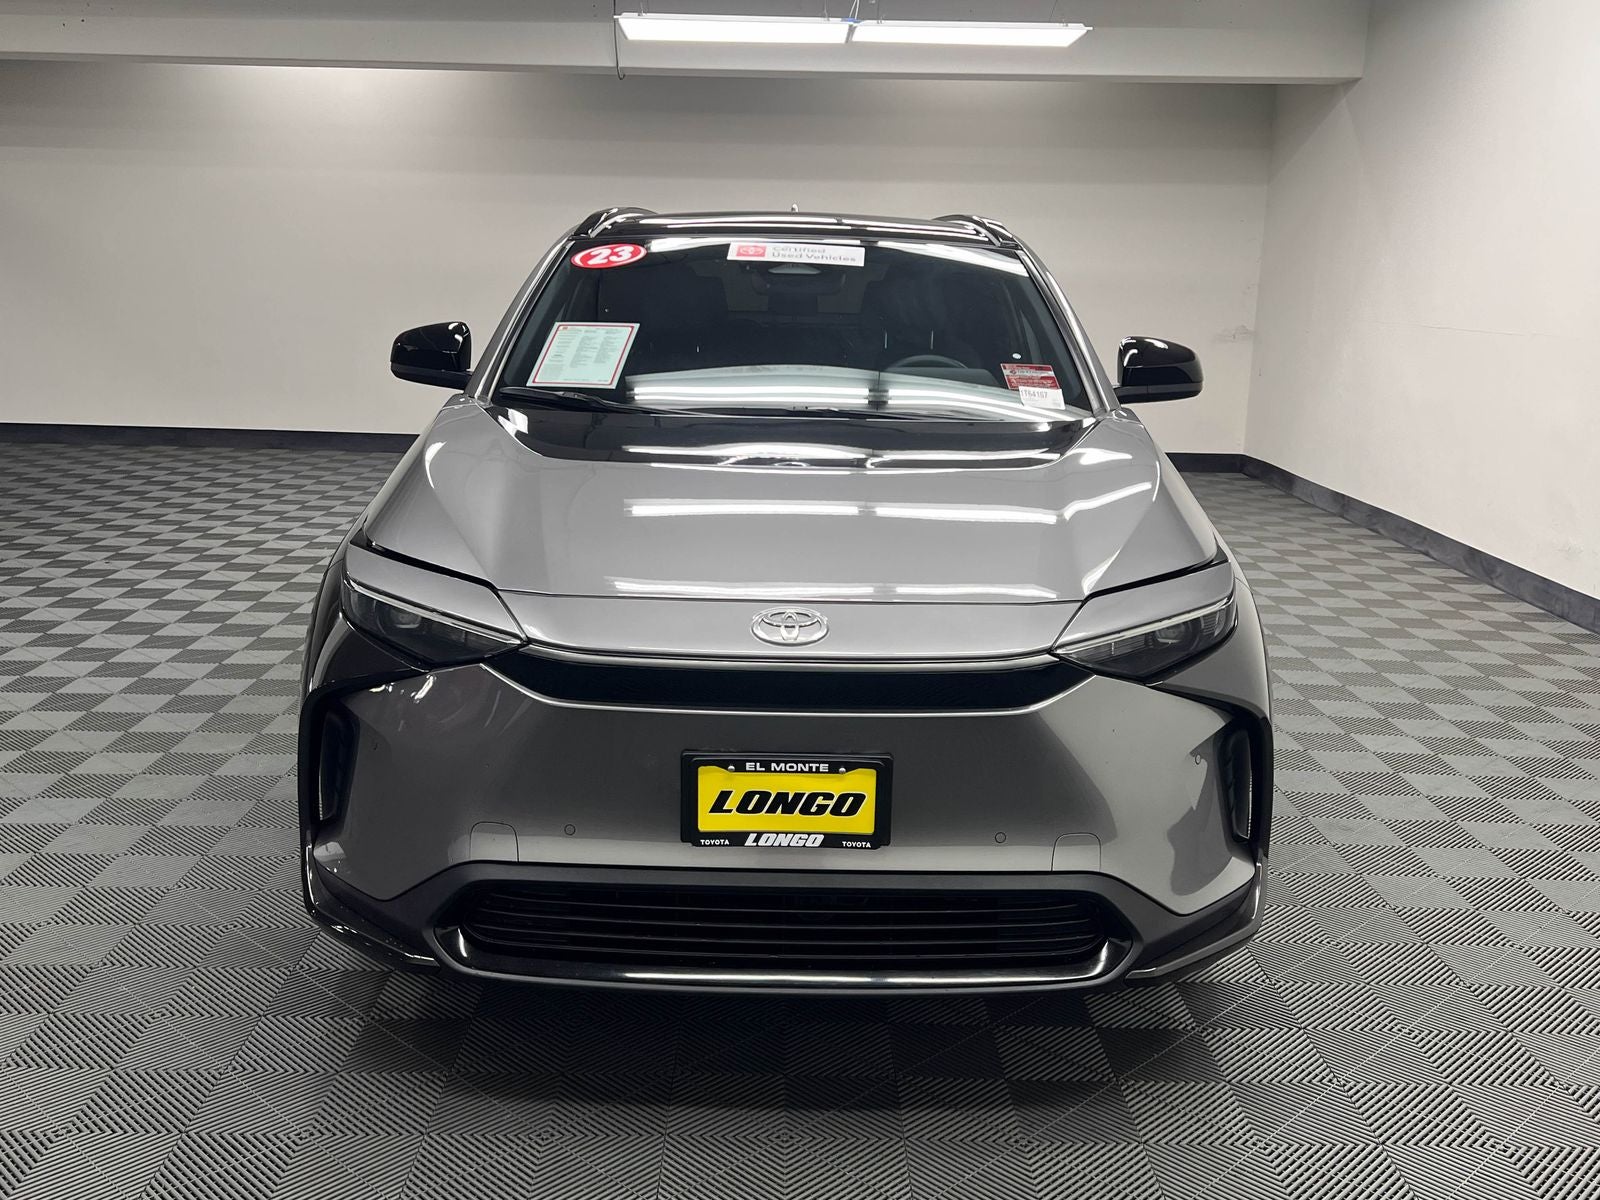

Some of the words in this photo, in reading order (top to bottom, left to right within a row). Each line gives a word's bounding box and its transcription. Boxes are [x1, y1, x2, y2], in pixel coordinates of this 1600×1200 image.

[772, 246, 827, 254] Certified
[587, 245, 635, 265] 23
[805, 253, 857, 262] Vehicles
[745, 762, 766, 772] EL
[770, 762, 830, 772] MONTE
[708, 789, 867, 817] LONGO
[700, 838, 730, 846] TOYOTA
[744, 833, 825, 848] LONGO
[842, 840, 872, 848] TOYOTA
